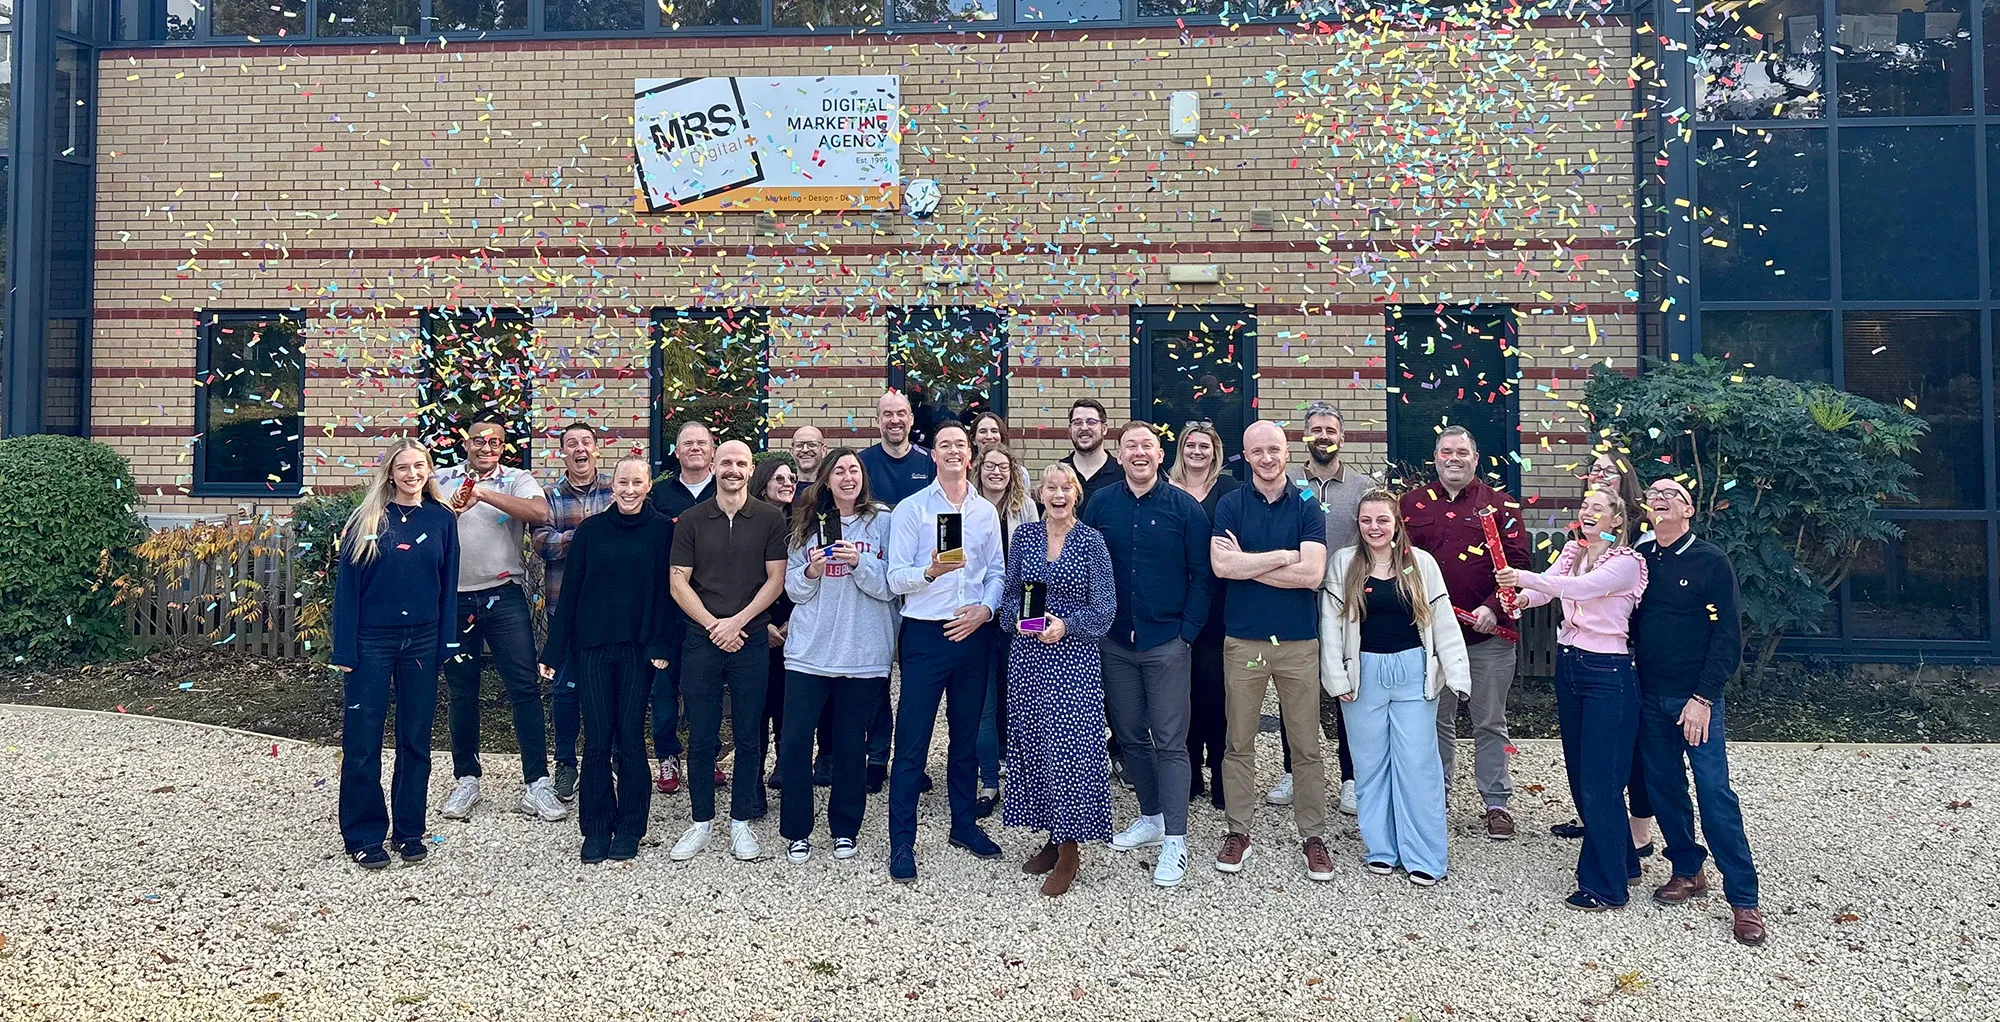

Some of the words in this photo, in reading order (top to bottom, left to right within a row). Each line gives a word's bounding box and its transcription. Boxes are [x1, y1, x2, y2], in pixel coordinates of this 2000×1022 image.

[822, 98, 888, 112] DIGITAL
[649, 103, 737, 155] MRS
[787, 116, 888, 131] MARKETING
[818, 134, 887, 148] AGENCY
[808, 194, 833, 203] Design
